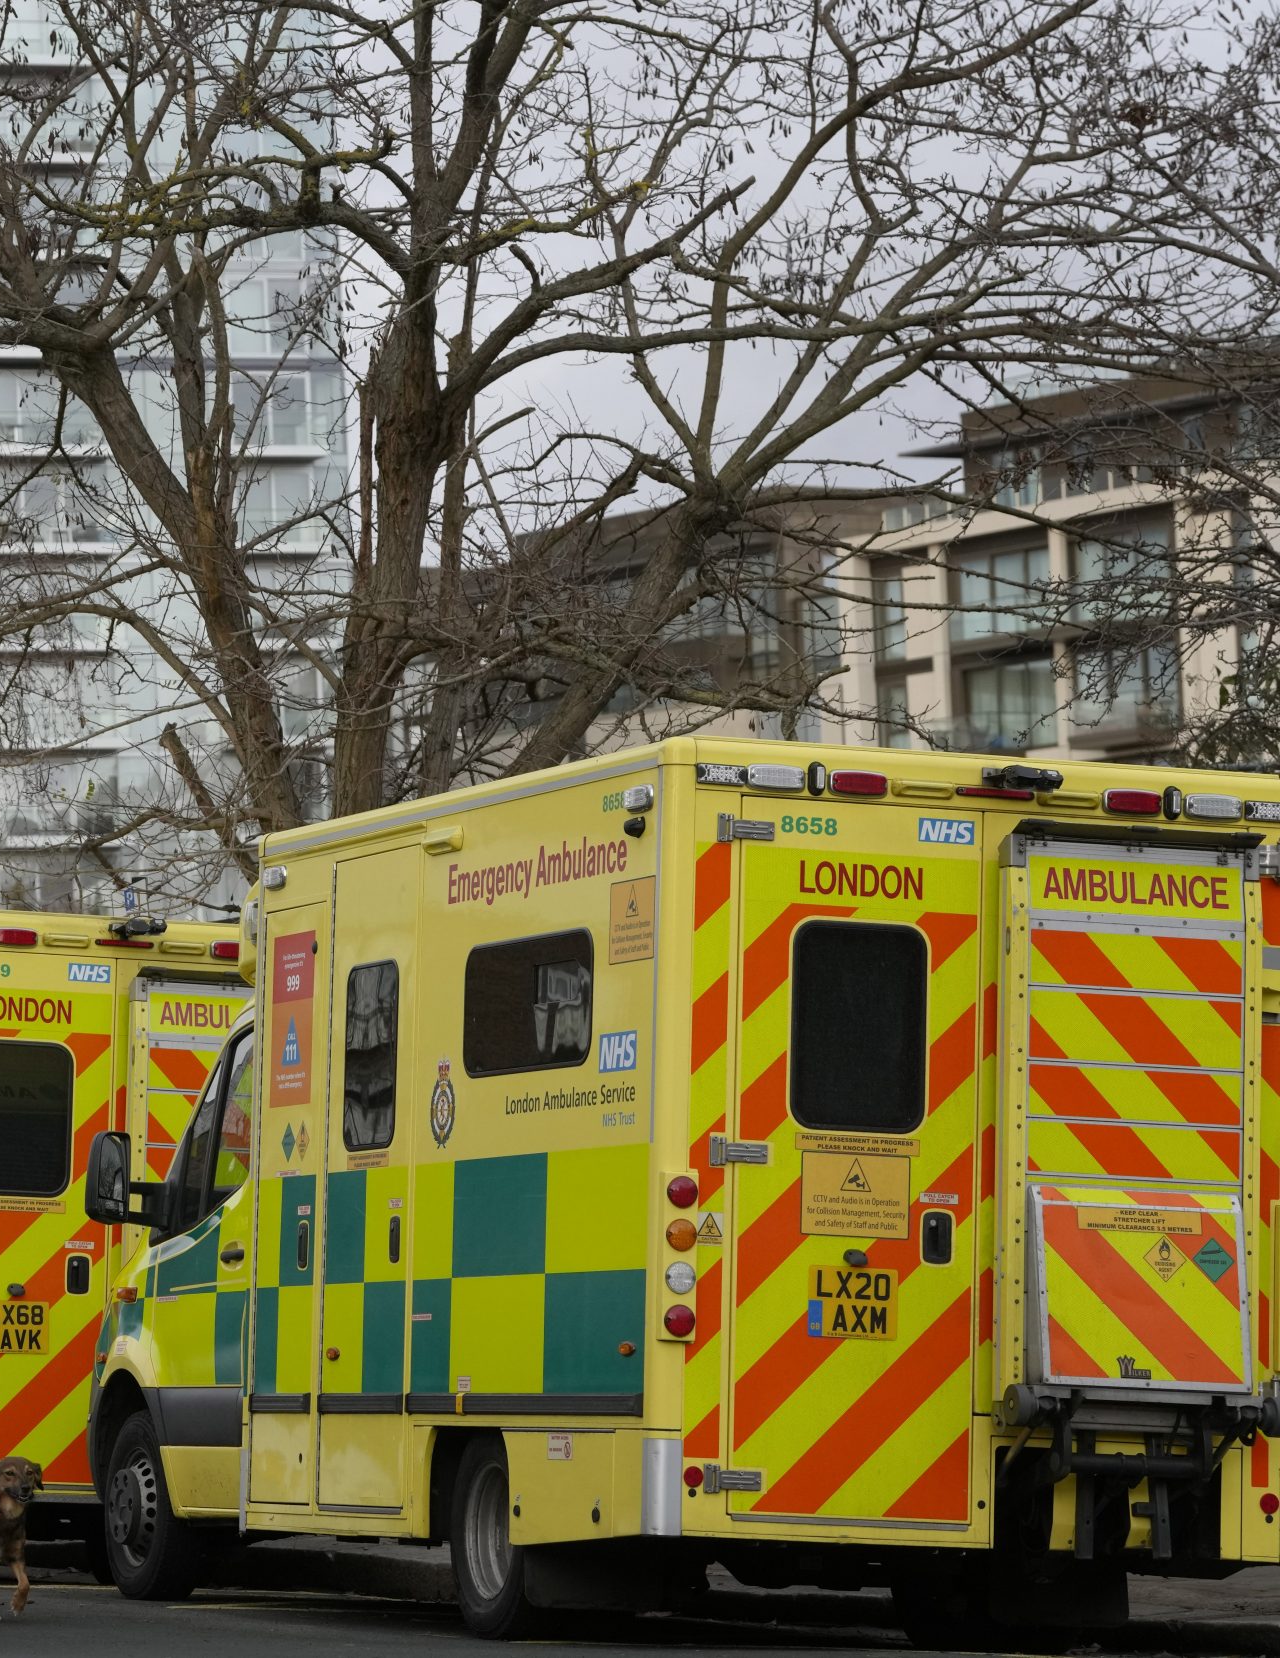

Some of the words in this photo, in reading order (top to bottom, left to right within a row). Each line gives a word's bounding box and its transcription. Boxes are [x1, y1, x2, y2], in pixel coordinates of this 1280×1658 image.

[780, 815, 838, 836] 8658
[919, 820, 973, 844] NHS
[447, 858, 533, 906] Emergency
[535, 836, 627, 888] Ambulance
[799, 859, 923, 900] LONDON
[1043, 866, 1230, 910] AMBULANCE
[69, 964, 110, 982] NHS
[286, 974, 300, 992] 999
[159, 1001, 232, 1030] AMBUL
[285, 1043, 297, 1061] 111
[600, 1033, 636, 1070] NHS
[505, 1092, 540, 1115] London
[542, 1086, 597, 1111] Ambulance
[600, 1081, 636, 1105] Service
[602, 1113, 617, 1127] NHS
[619, 1111, 635, 1126] Trust
[801, 1134, 828, 1142] PATIENT
[828, 1136, 870, 1144] ASSESSMENT
[879, 1139, 914, 1147] PROGRESS
[813, 1194, 828, 1203] CCTV
[828, 1195, 840, 1204] and
[840, 1196, 858, 1205] Audio
[871, 1198, 900, 1208] Operation
[807, 1206, 815, 1214] for
[816, 1206, 840, 1216] Collision
[841, 1209, 882, 1219] Management,
[882, 1210, 906, 1221] Security
[1113, 1216, 1150, 1224] STRETCHER
[1119, 1209, 1137, 1217] KEEP
[1137, 1210, 1159, 1218] CLEAR
[814, 1219, 826, 1227] and
[827, 1220, 845, 1230] Safety
[853, 1221, 868, 1229] Staff
[867, 1222, 879, 1230] and
[879, 1222, 898, 1231] Public
[1087, 1222, 1117, 1230] MINIMUM
[1117, 1223, 1156, 1232] CLEARANCE
[816, 1269, 891, 1301] LX20
[810, 1322, 821, 1330] GB
[832, 1304, 887, 1334] AXM
[0, 1328, 41, 1350] AVK
[1116, 1354, 1151, 1379] WILKER
